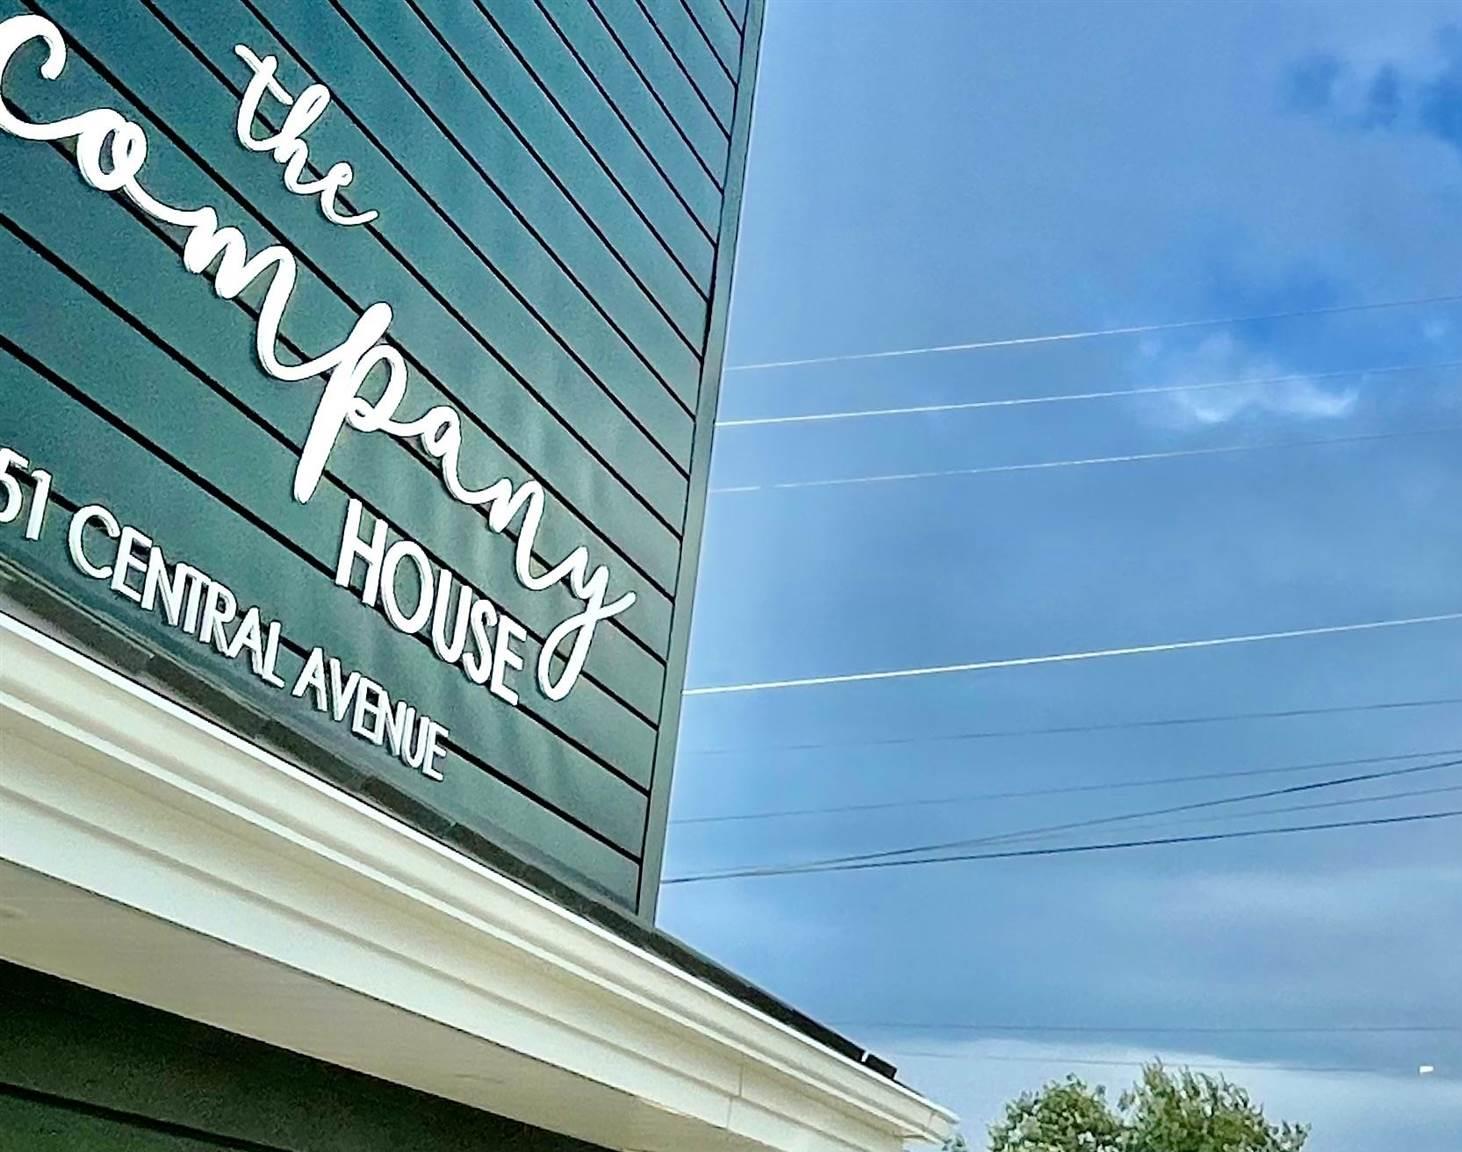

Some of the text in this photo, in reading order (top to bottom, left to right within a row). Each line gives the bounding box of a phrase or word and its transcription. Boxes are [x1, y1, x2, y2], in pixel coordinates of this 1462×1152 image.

[234, 44, 379, 226] the
[0, 447, 450, 782] 51 CENTRAL AVENUE
[335, 498, 529, 706] HOUSE
